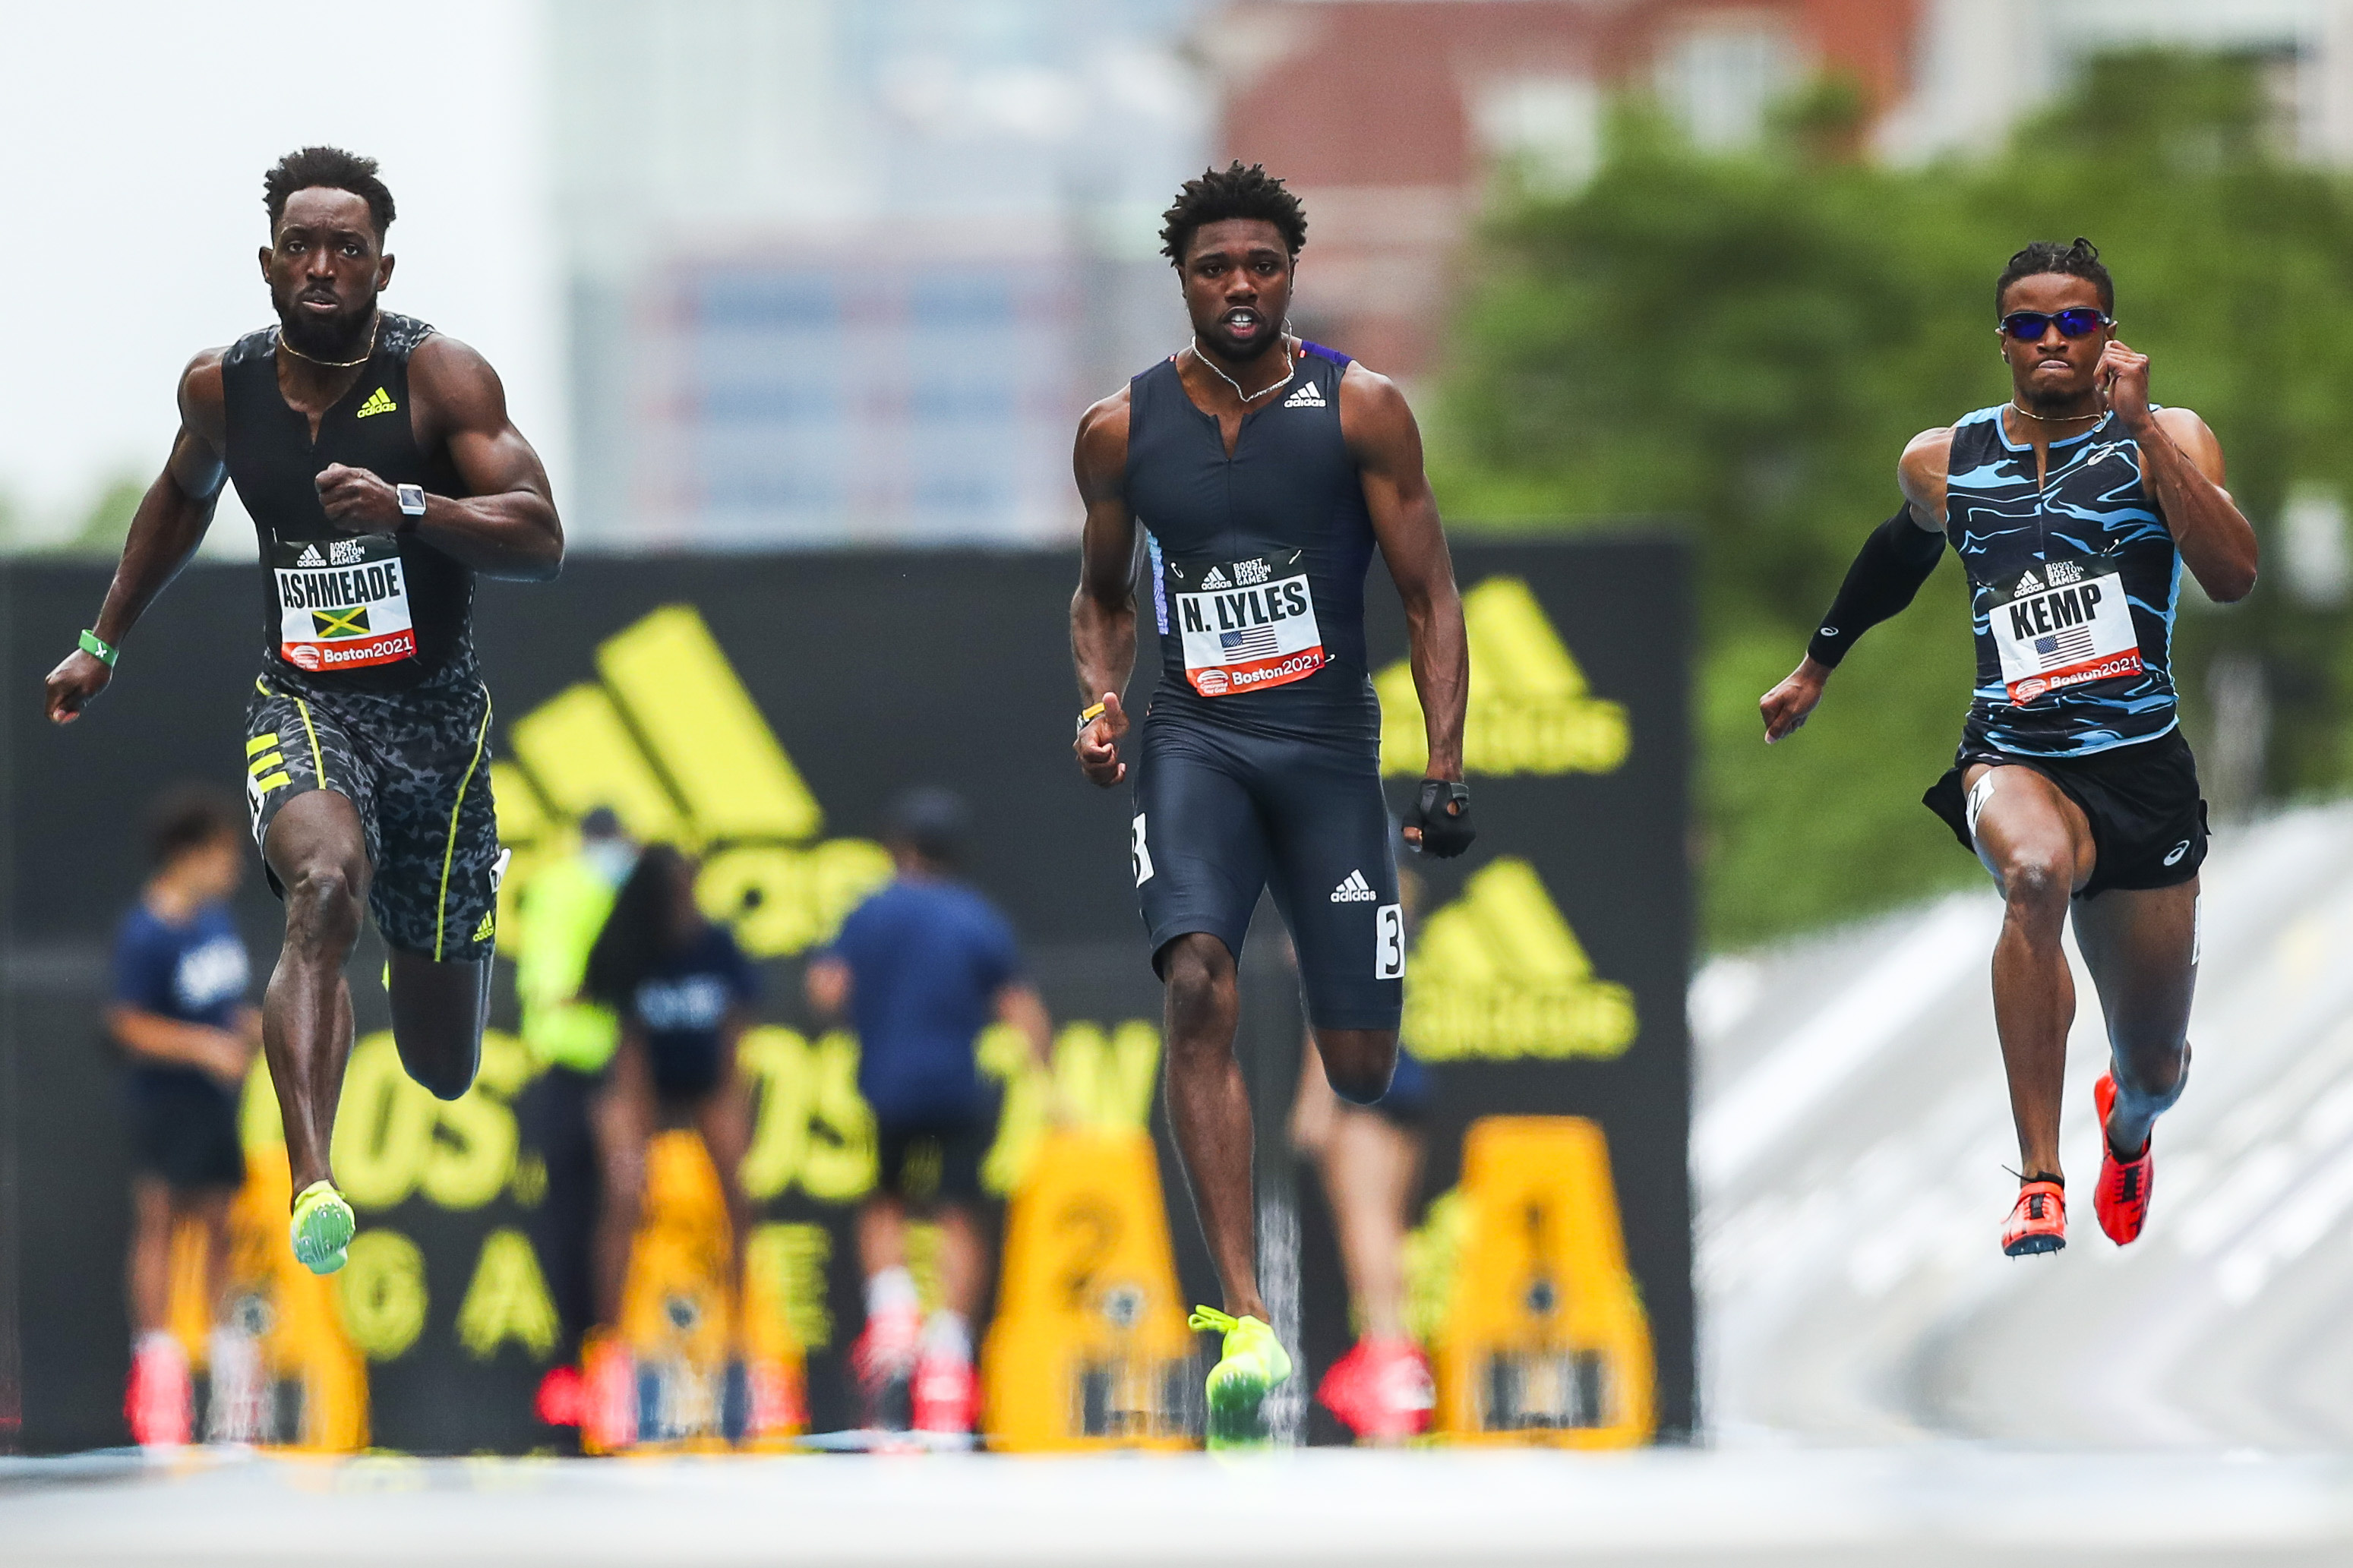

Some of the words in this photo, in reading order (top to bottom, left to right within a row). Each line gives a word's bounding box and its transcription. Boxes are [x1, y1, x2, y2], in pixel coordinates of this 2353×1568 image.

[1284, 397, 1326, 408] adidas
[357, 402, 396, 418] adidas
[330, 539, 358, 550] BOOST
[330, 546, 365, 558] BOSTON
[297, 559, 327, 567] adidas
[330, 554, 362, 565] GAMES
[1233, 557, 1262, 570] BOOST
[2045, 560, 2073, 571] BOOST
[1234, 564, 1271, 578] BOSTON
[2047, 566, 2084, 579] BOSTON
[280, 563, 401, 609] ASHMEADE
[1201, 580, 1232, 590] adidas
[1237, 573, 1268, 585] GAMES
[2048, 573, 2081, 587] GAMES
[2013, 582, 2045, 598] adidas
[1182, 597, 1211, 632] N.
[1214, 581, 1307, 630] LYLES
[2009, 583, 2102, 641] KEMP
[324, 636, 413, 663] Boston2021
[1232, 654, 1320, 685] Boston2021
[2049, 656, 2140, 688] Boston2021
[1331, 888, 1376, 902] adidas
[1385, 910, 1401, 974] 3
